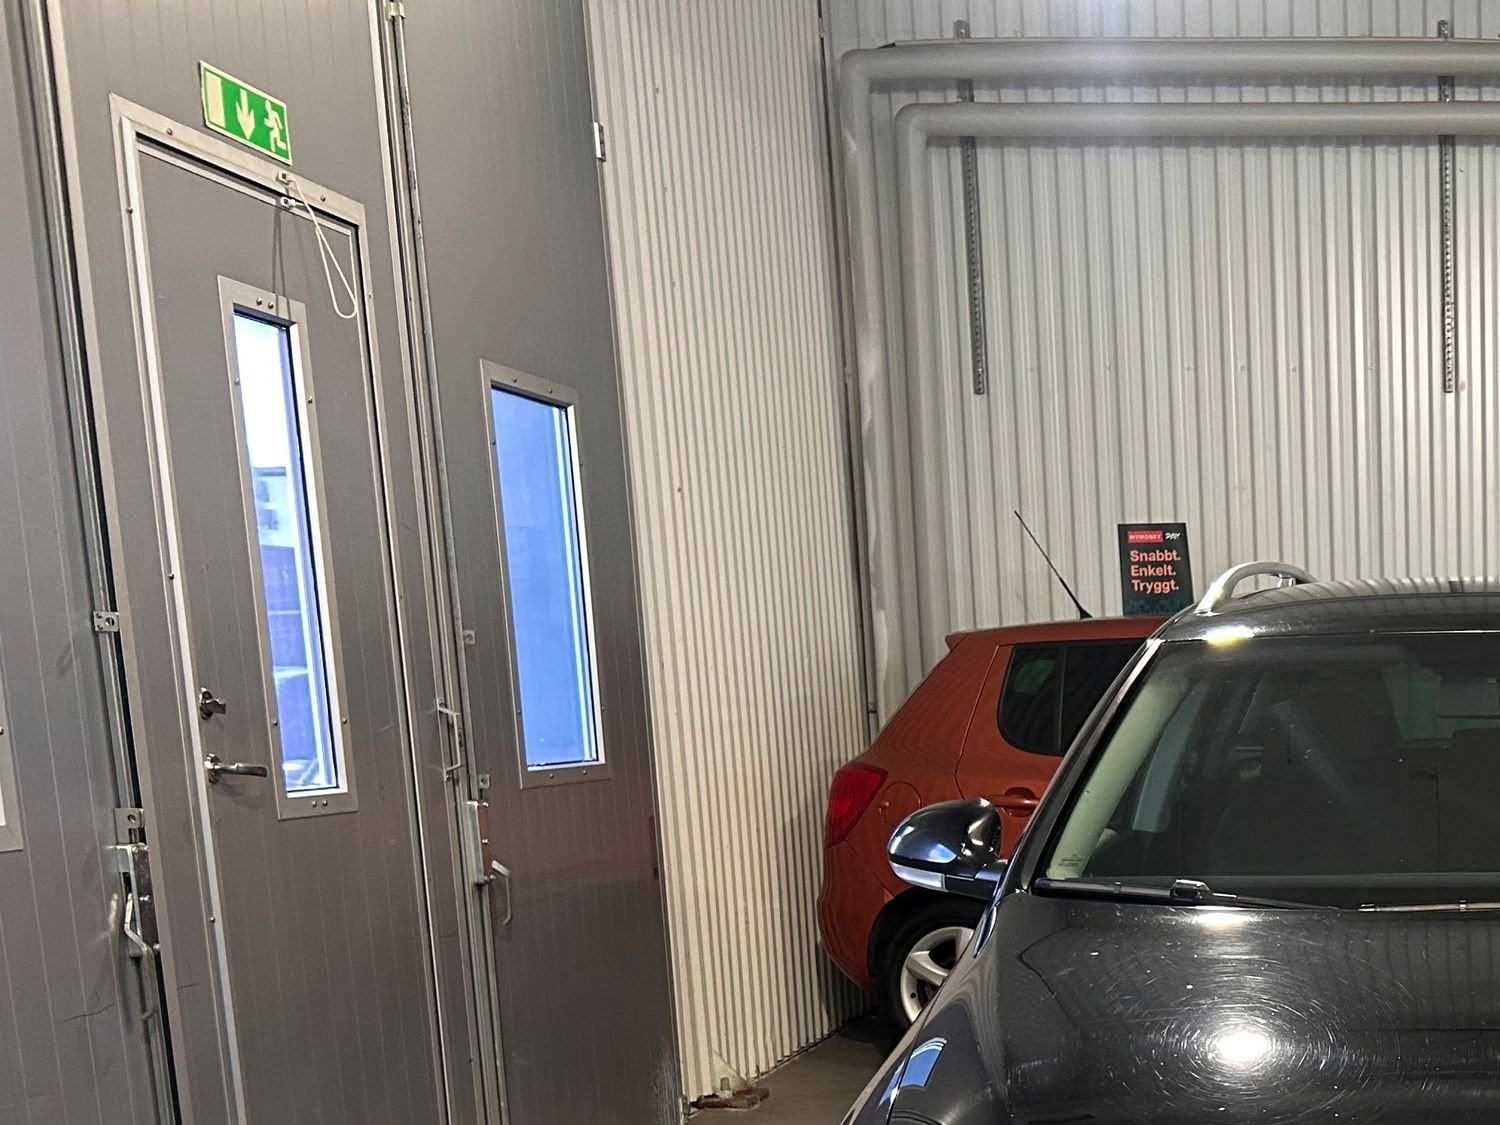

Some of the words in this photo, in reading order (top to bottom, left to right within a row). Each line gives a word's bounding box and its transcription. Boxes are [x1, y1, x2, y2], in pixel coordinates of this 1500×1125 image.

[1129, 549, 1181, 562] Snabbt.
[1130, 564, 1177, 577] Enkelt.
[1132, 580, 1180, 594] Tryggt.
